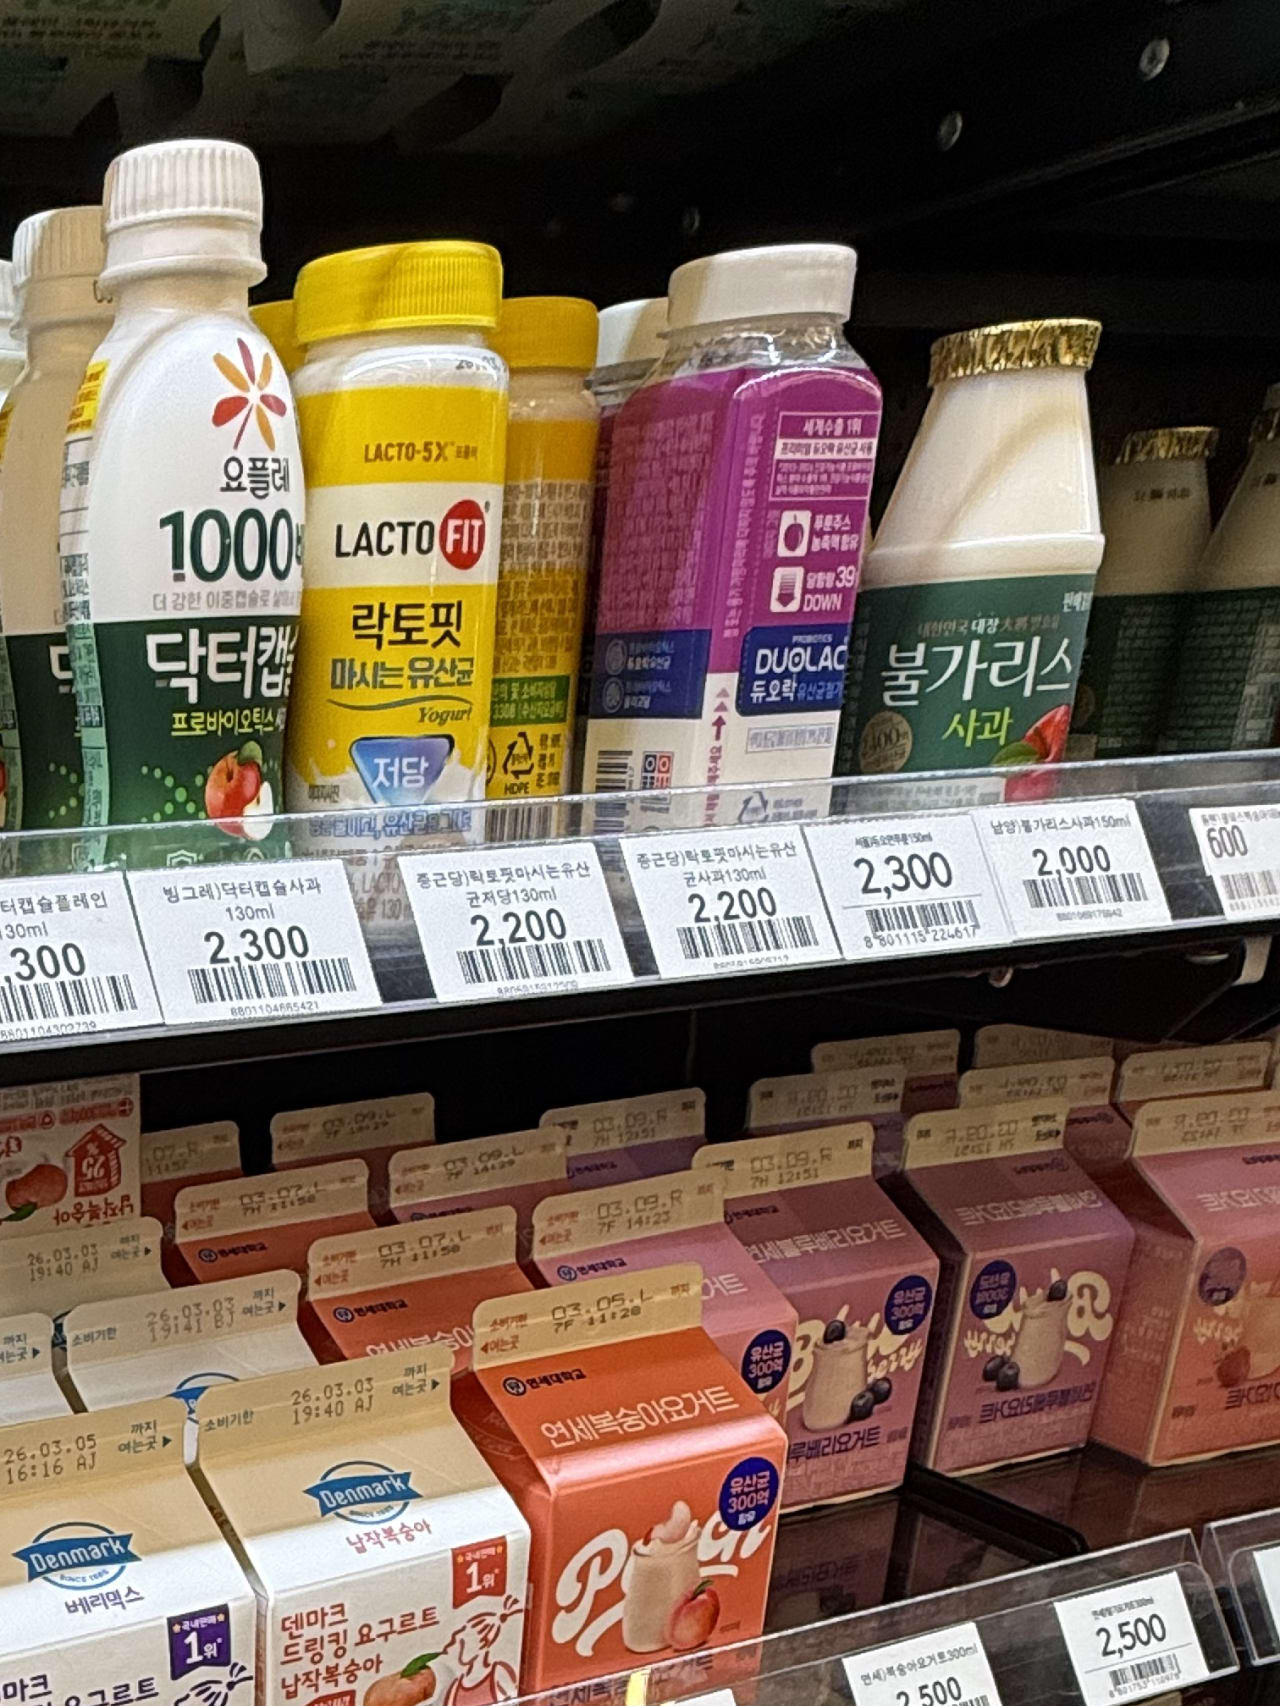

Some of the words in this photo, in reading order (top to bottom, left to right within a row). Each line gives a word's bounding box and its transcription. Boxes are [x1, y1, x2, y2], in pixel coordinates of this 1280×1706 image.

[220, 457, 290, 496] 요플레
[335, 521, 434, 558] LACTO
[445, 518, 484, 553] FIT
[803, 592, 842, 612] DOWN
[351, 601, 464, 649] 락토핏
[331, 658, 404, 691] 마시는
[407, 657, 474, 688] 유산균
[880, 636, 1073, 707] 불가리스
[750, 681, 798, 705] 듀오락
[171, 711, 275, 736] 프로바이오틱스
[418, 706, 473, 726] Yogurt
[942, 707, 1014, 747] 사과
[371, 754, 429, 790] 저당
[853, 851, 952, 900] 2,300
[1032, 845, 1111, 878] 2,000
[163, 877, 323, 904] 빙그레)닥터캡슐사과
[688, 886, 777, 924] 2,200
[225, 905, 277, 922] 130ml
[470, 908, 567, 948] 2,200
[204, 925, 310, 966] 2,300
[539, 1381, 740, 1450] 연세복숭아요거트
[6, 1458, 64, 1485] 16:16
[76, 1453, 97, 1473] AJ
[728, 1471, 772, 1496] 유산균
[32, 1538, 125, 1573] Denmark
[281, 1603, 348, 1640] 덴마크
[281, 1631, 349, 1666] 드링킹
[354, 1606, 440, 1650] 요구르트
[1095, 1614, 1167, 1658] 2,500
[280, 1655, 383, 1699] 납작복숭아
